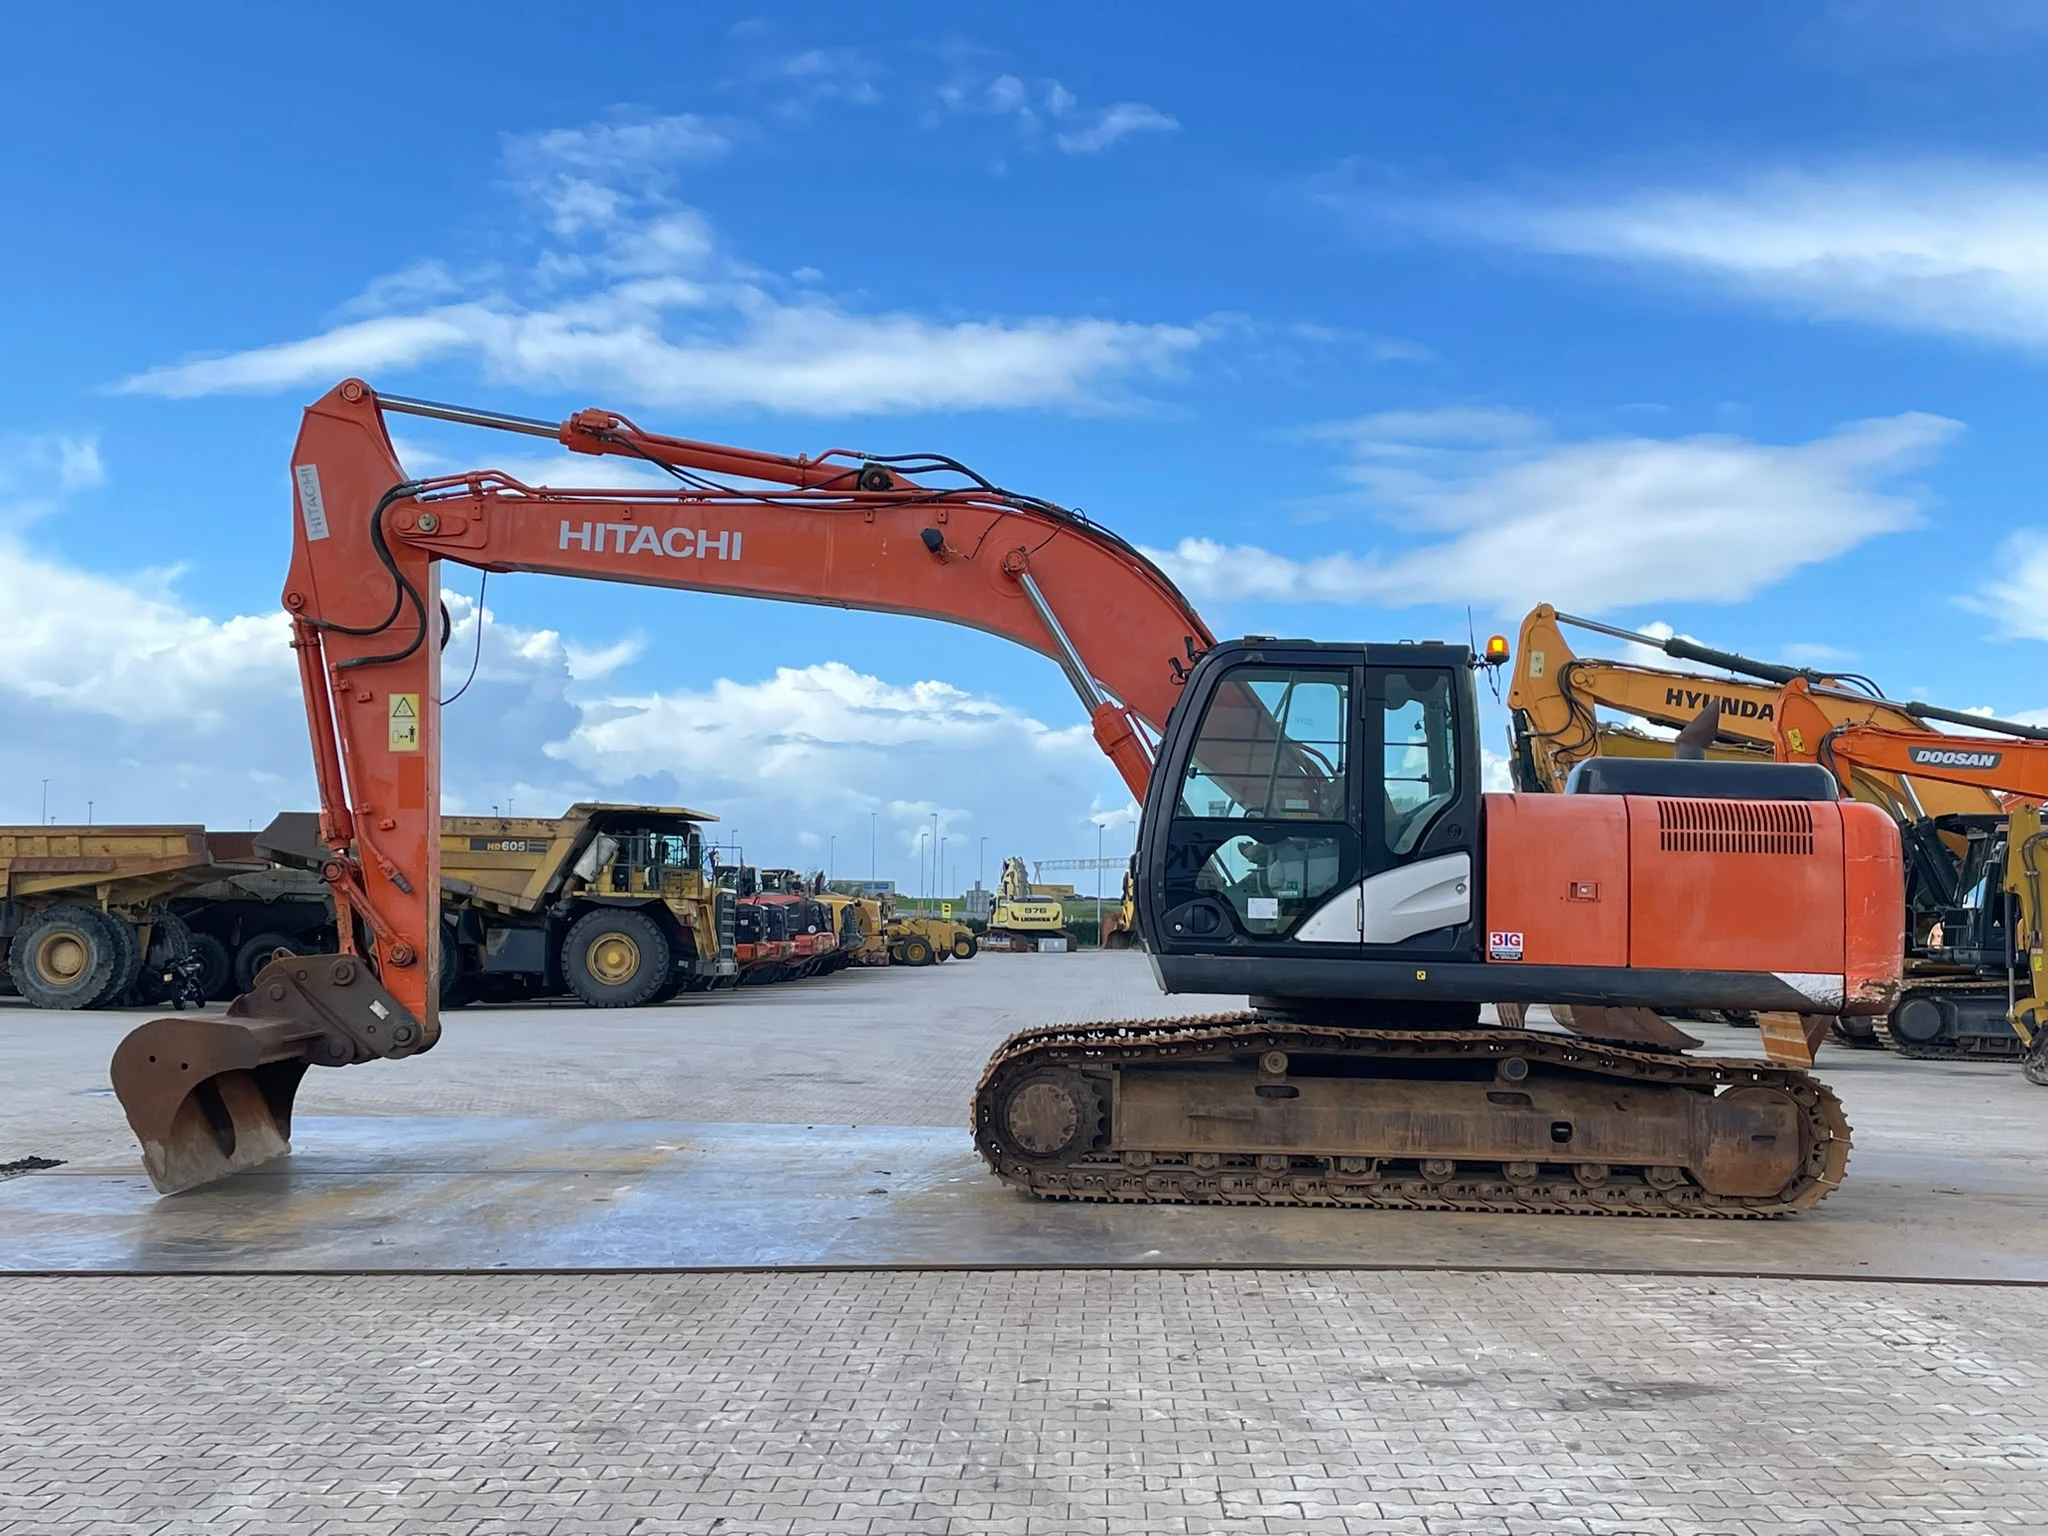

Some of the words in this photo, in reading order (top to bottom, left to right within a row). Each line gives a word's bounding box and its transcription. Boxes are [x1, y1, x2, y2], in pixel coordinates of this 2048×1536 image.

[300, 466, 324, 535] HITACHI
[559, 520, 742, 561] HITACHI
[1916, 750, 1995, 767] DOOSAN
[487, 841, 526, 851] HD605
